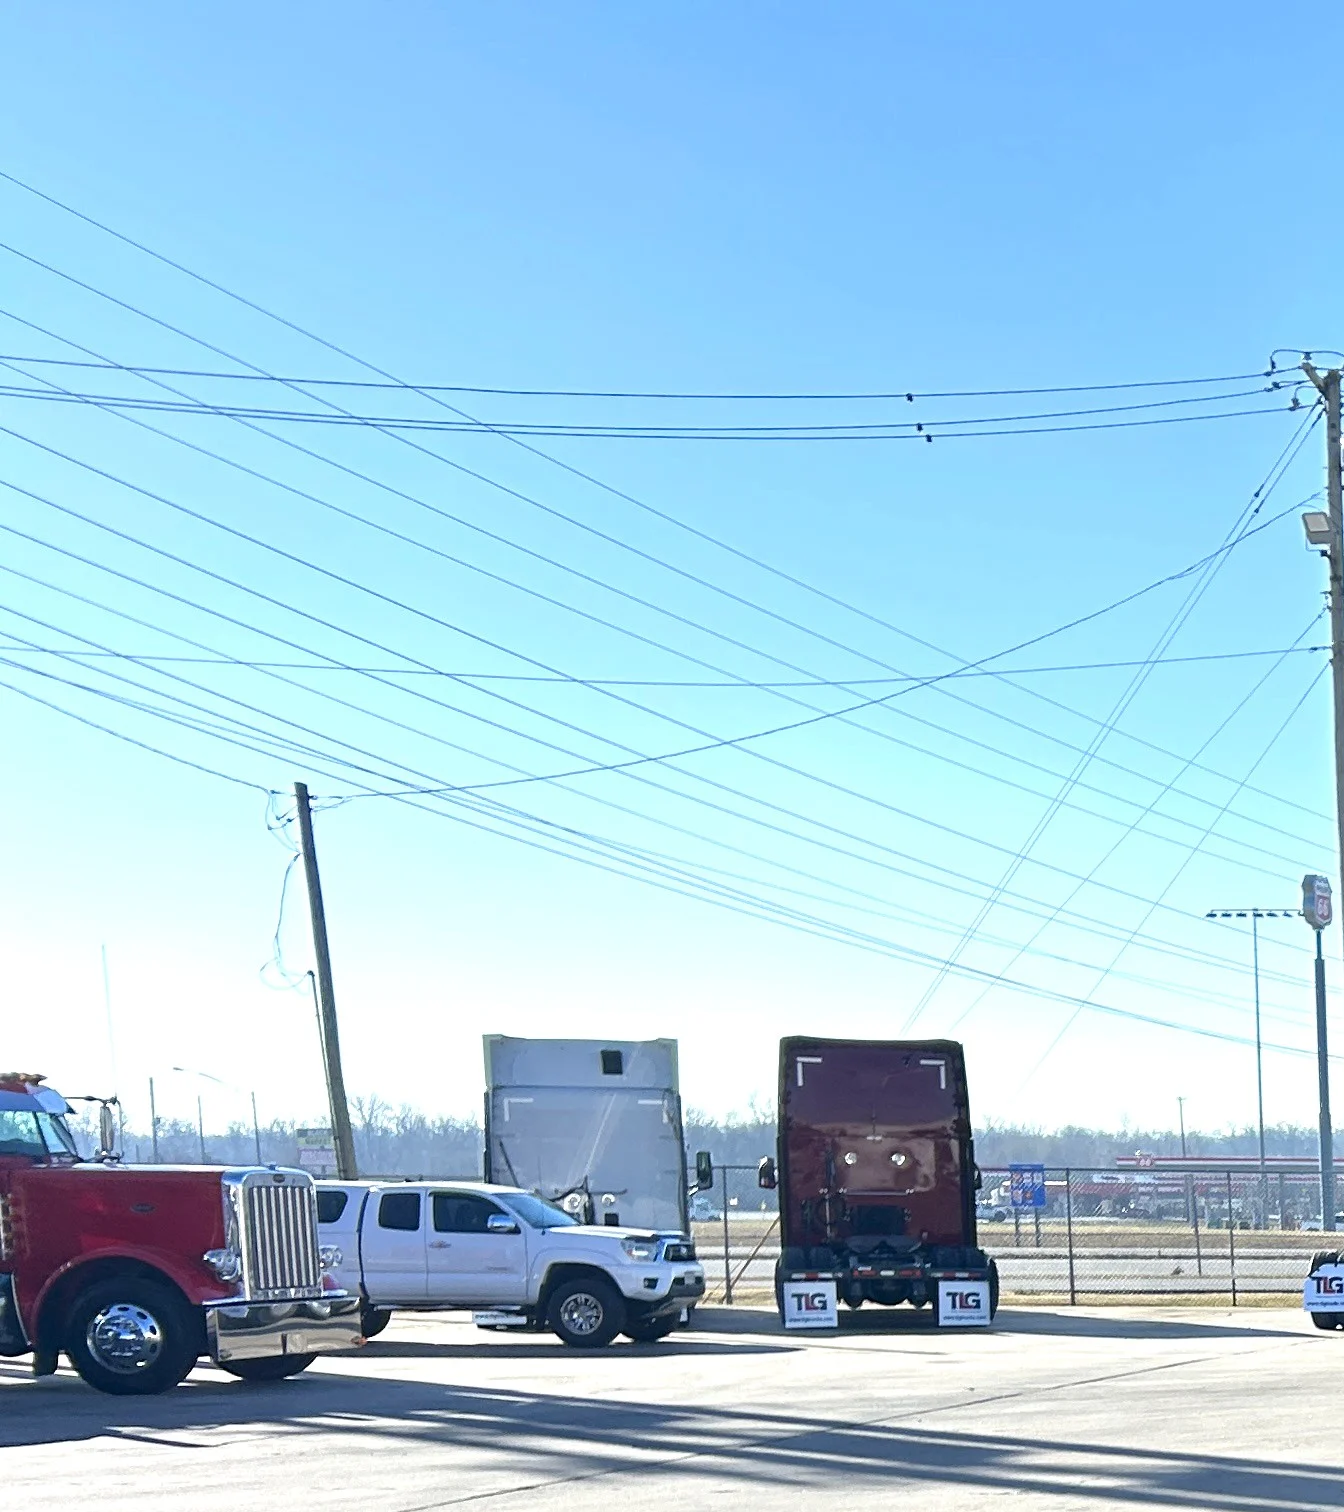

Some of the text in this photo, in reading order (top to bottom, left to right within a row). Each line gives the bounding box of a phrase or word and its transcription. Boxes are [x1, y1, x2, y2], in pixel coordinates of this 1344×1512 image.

[1310, 1276, 1344, 1294] TLG
[791, 1292, 827, 1311] TLG
[945, 1291, 981, 1309] TLG
